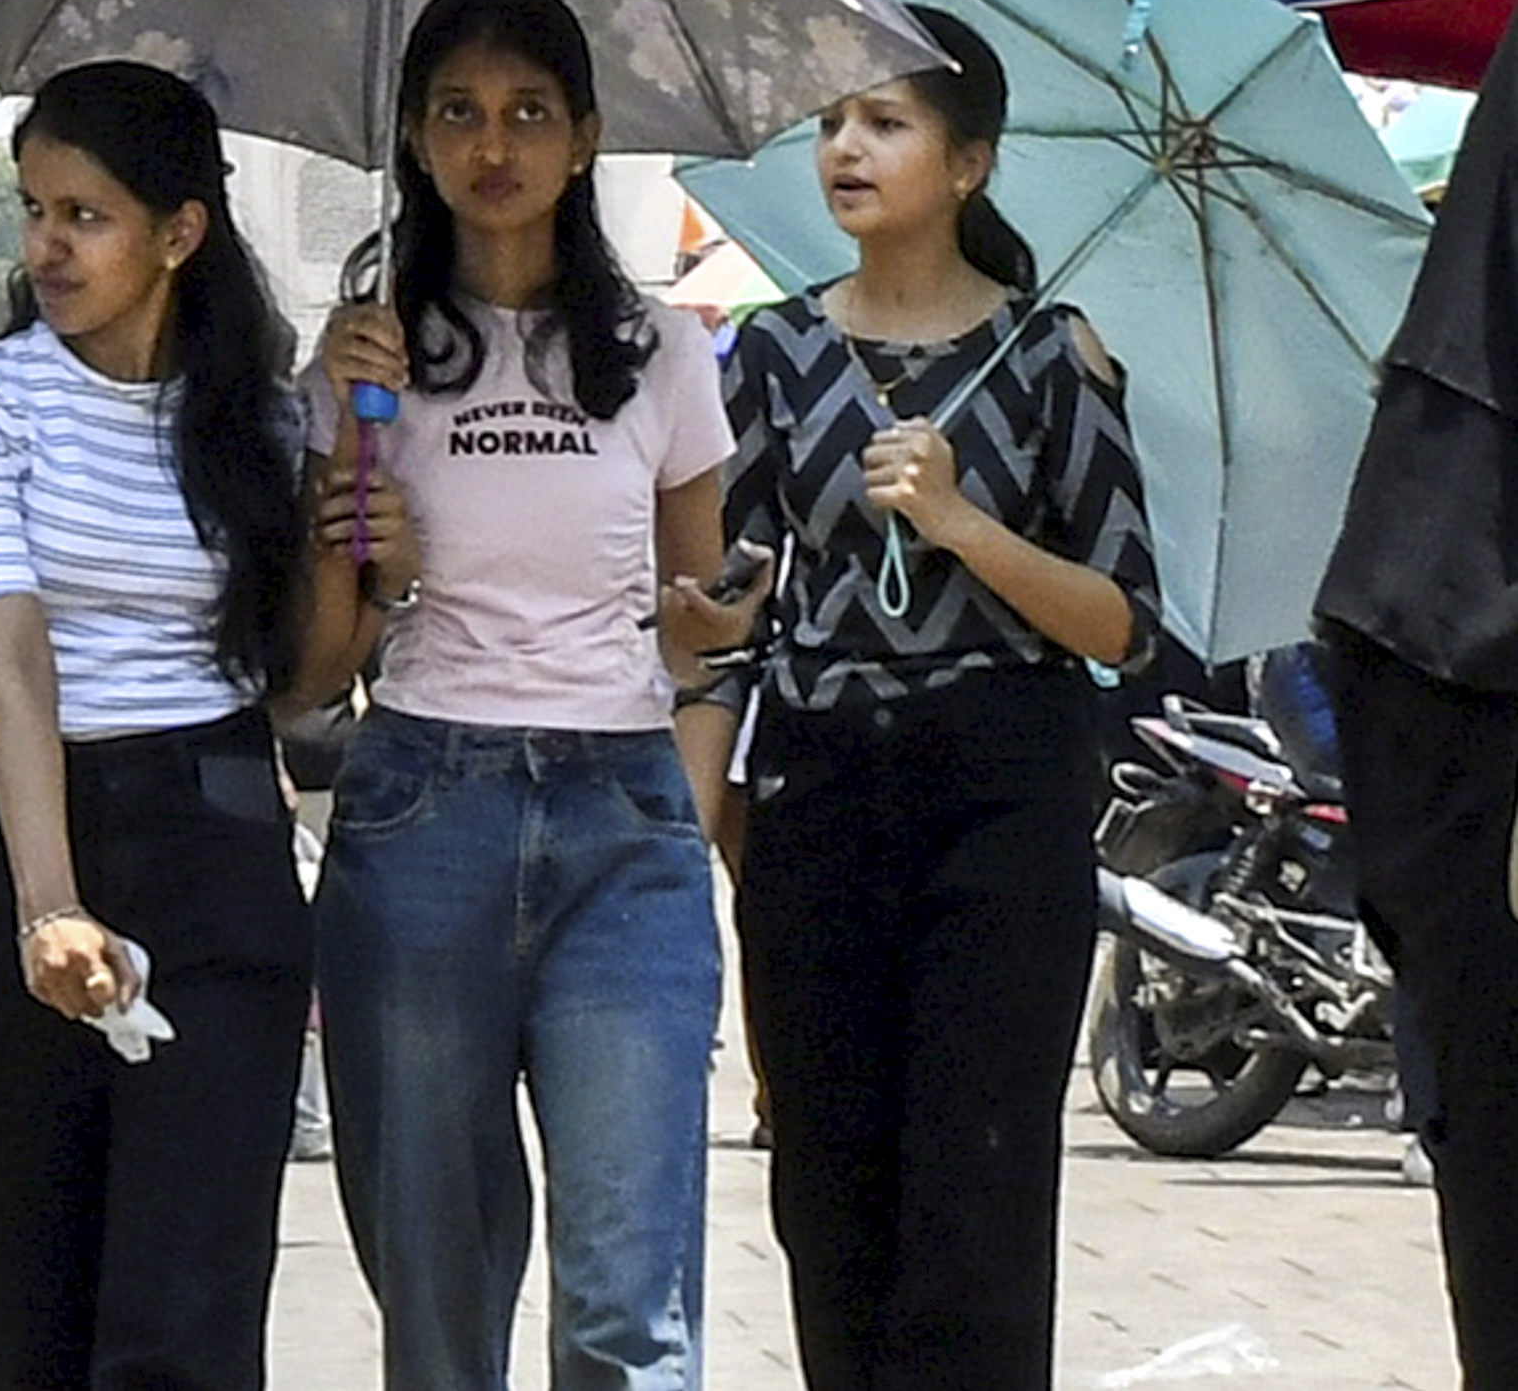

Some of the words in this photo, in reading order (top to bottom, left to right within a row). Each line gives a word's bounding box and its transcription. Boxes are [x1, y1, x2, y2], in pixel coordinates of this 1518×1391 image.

[453, 401, 526, 426] NEVER
[532, 401, 586, 427] BEEN
[449, 431, 598, 456] NORMAL
